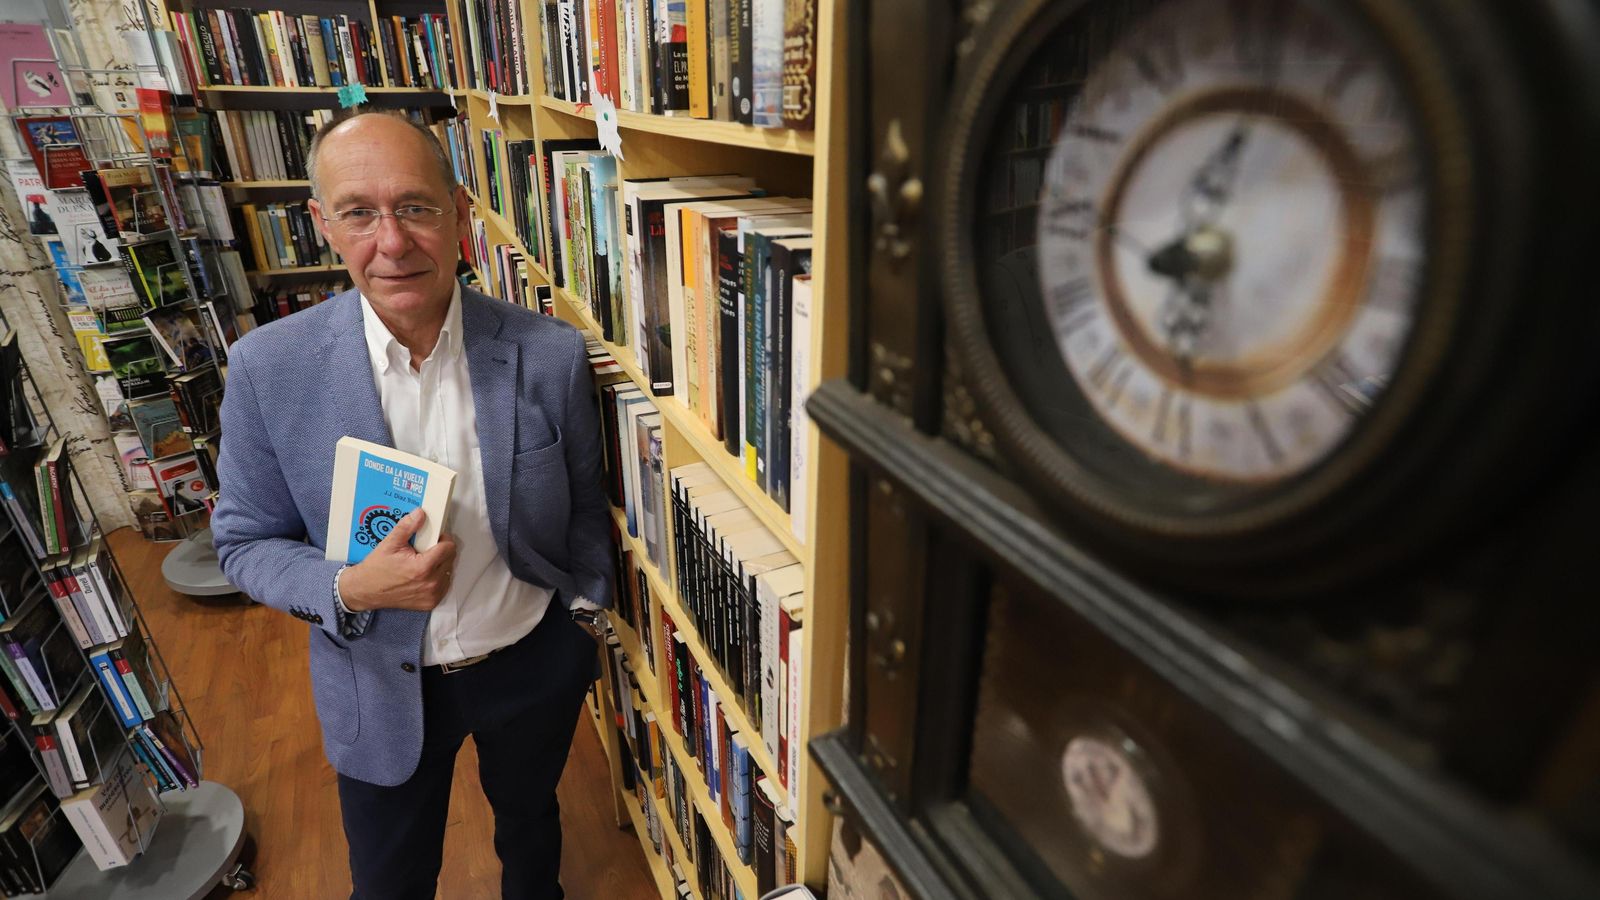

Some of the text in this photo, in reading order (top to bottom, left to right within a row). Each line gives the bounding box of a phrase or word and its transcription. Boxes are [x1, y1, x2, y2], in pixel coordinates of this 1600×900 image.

[18, 178, 42, 187] PATR
[364, 458, 424, 486] DONDE DA LA VUELTA
[393, 476, 400, 486] EL
[401, 479, 423, 494] TIEMPO
